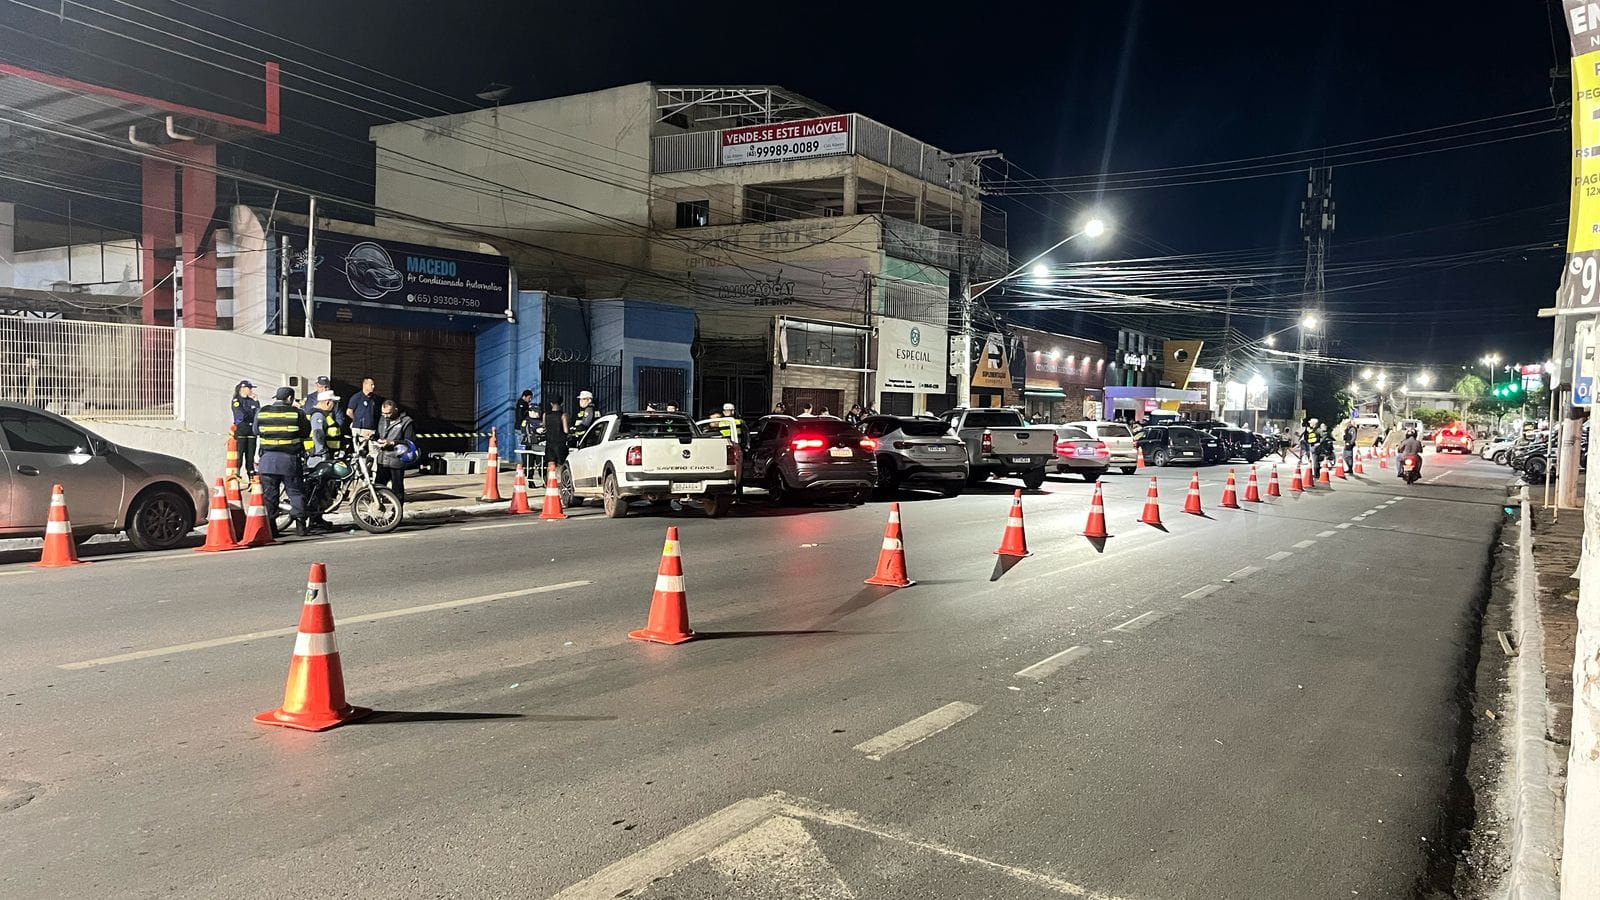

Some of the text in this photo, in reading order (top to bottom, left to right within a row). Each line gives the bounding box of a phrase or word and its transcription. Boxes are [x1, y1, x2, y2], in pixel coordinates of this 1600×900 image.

[727, 120, 844, 144] VENDE-SE ESTE IMÓVEL
[756, 140, 820, 158] 99989-0089
[1575, 174, 1600, 187] PAG
[406, 256, 457, 277] MACEDO
[407, 273, 503, 291] Ar Condicionado Automotivo
[1581, 256, 1600, 305] 9
[414, 294, 480, 308] (65) 99308-7580
[896, 348, 931, 362] ESPECIAL
